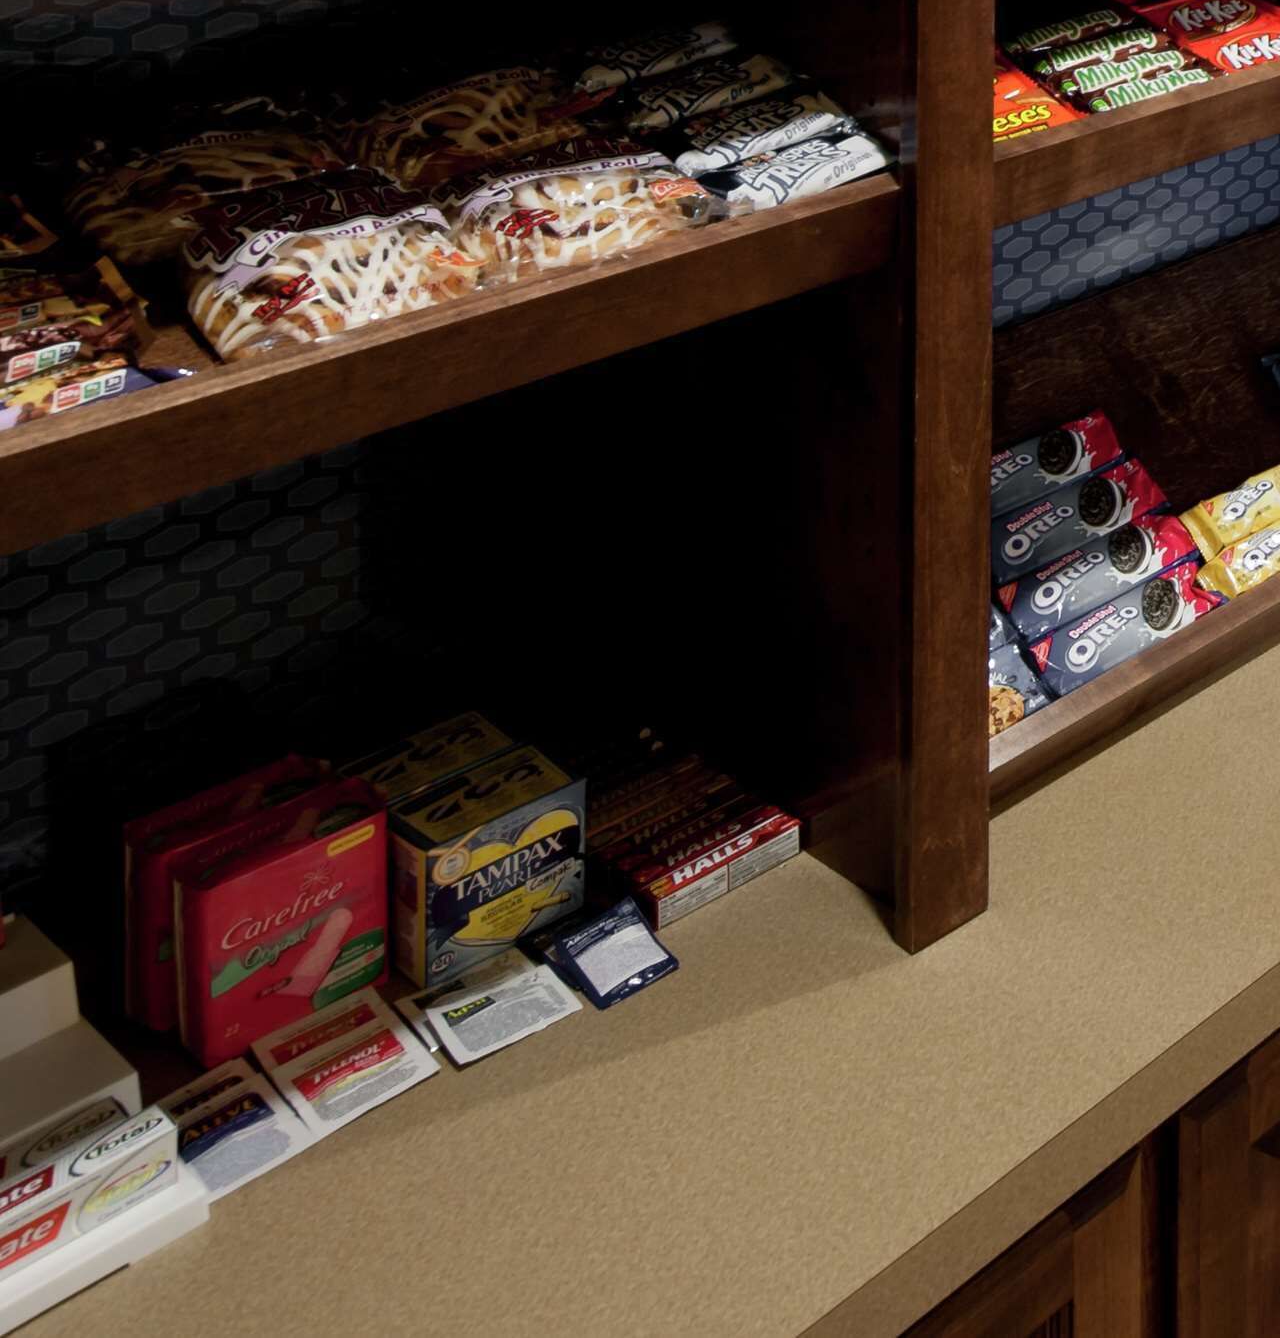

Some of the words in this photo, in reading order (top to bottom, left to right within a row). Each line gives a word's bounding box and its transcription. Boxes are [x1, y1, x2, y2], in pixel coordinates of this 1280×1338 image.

[496, 67, 532, 81] Roll
[704, 100, 804, 162] TREATS
[785, 109, 827, 140] Original
[993, 105, 1052, 132] ese's
[490, 163, 594, 191] Cinnamon
[601, 157, 638, 170] Roll
[750, 146, 850, 205] TREATS
[992, 453, 1033, 486] REO
[1223, 479, 1274, 522] OREO
[1004, 506, 1074, 559] OREO
[1031, 551, 1105, 615] OREO
[1065, 606, 1139, 672] OREO
[449, 831, 564, 901] TAMPAX
[667, 823, 743, 867] HALLS
[670, 835, 754, 886] HALLS
[221, 881, 344, 951] Carefree
[244, 921, 313, 968] Original
[311, 1040, 386, 1084] TYLENOL
[84, 1117, 163, 1161] Total
[181, 1098, 257, 1144] ALEVE
